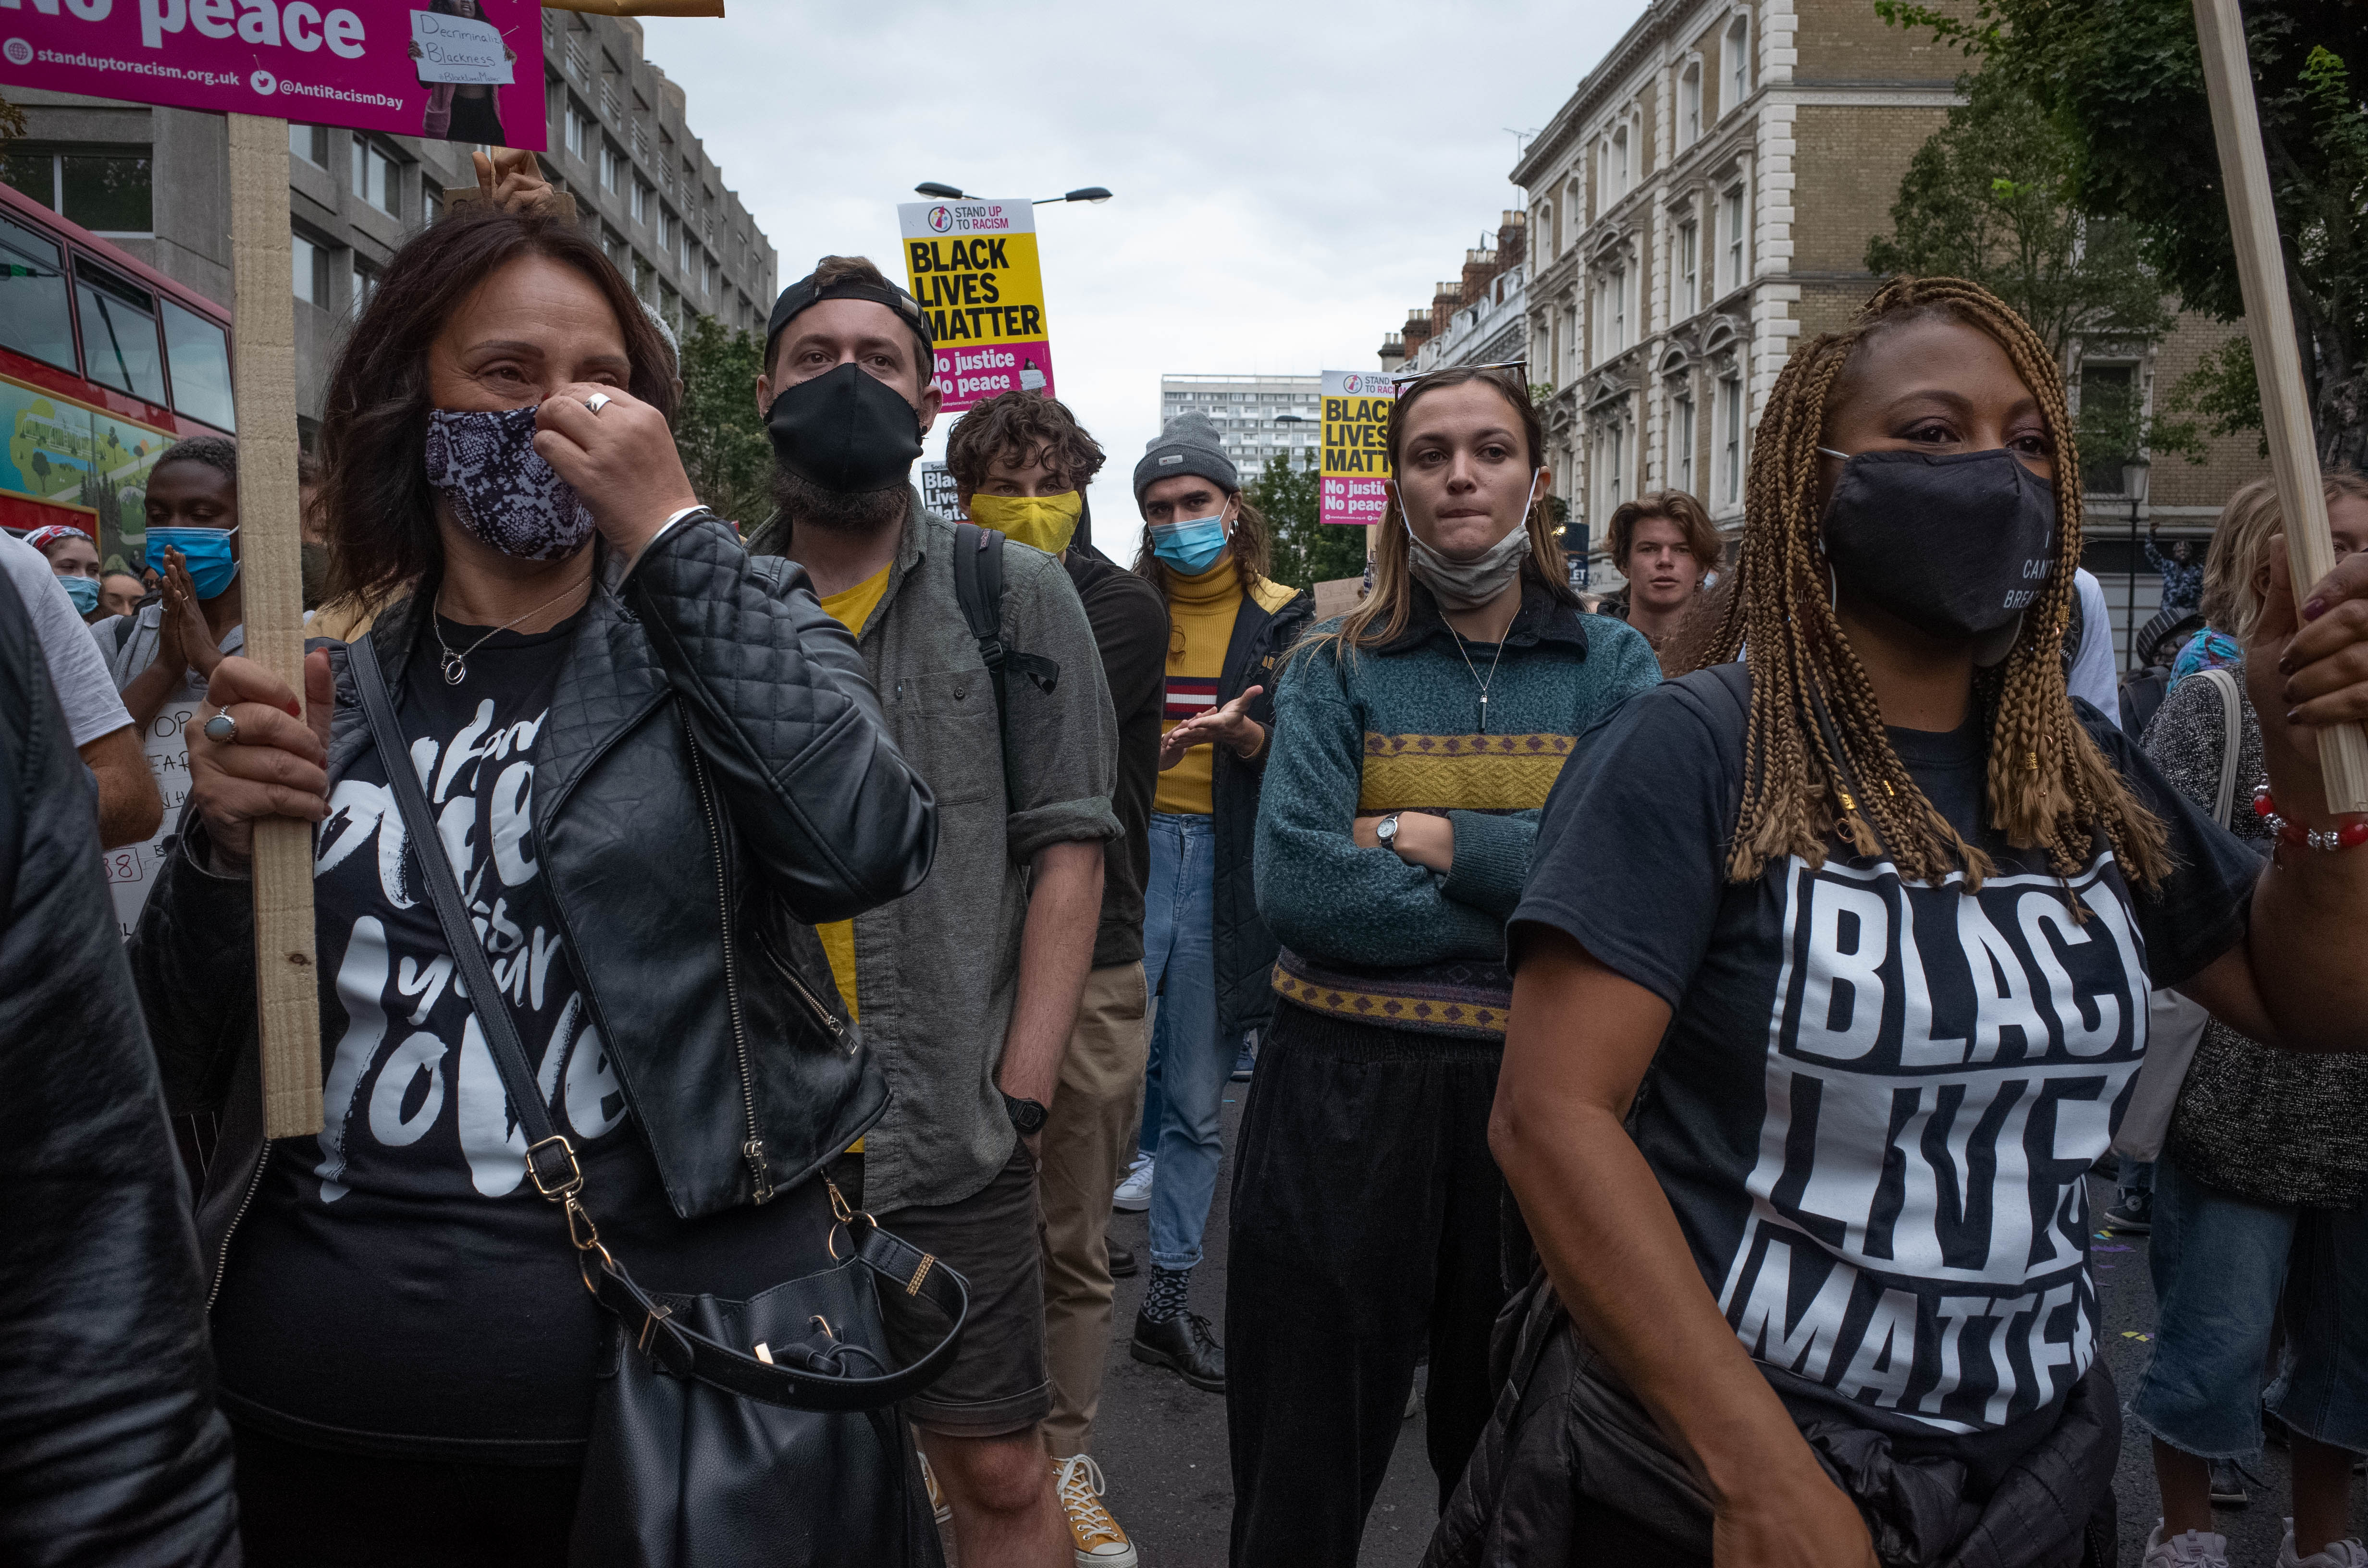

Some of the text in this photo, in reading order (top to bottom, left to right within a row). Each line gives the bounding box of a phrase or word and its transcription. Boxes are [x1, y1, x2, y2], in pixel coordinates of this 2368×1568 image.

[139, 0, 366, 59] peace
[426, 42, 495, 66] Blackness
[37, 49, 239, 86] standuptoracism.org.uk
[280, 80, 403, 111] @AntiRacismDay
[955, 206, 1002, 219] STAND UP
[956, 217, 1009, 230] TO RACISM
[910, 238, 1010, 273] BLACK
[914, 272, 1000, 308] LIVES
[925, 305, 1042, 342] MATTER
[954, 349, 1015, 376] justice
[958, 374, 1011, 398] peace
[1365, 377, 1390, 385] STAND
[1378, 386, 1407, 394] RACIM
[1326, 424, 1388, 447] LIVES
[1326, 449, 1389, 473] MATT
[924, 472, 958, 489] Blac
[1325, 479, 1385, 498] No justic
[925, 489, 958, 506] Live
[1325, 496, 1345, 510] No
[927, 505, 968, 520] Mat
[2045, 530, 2049, 549] I
[2003, 590, 2039, 609] BREA
[148, 710, 192, 740] OP
[472, 900, 523, 953] is
[398, 925, 562, 1025] yur
[313, 915, 628, 1203] love
